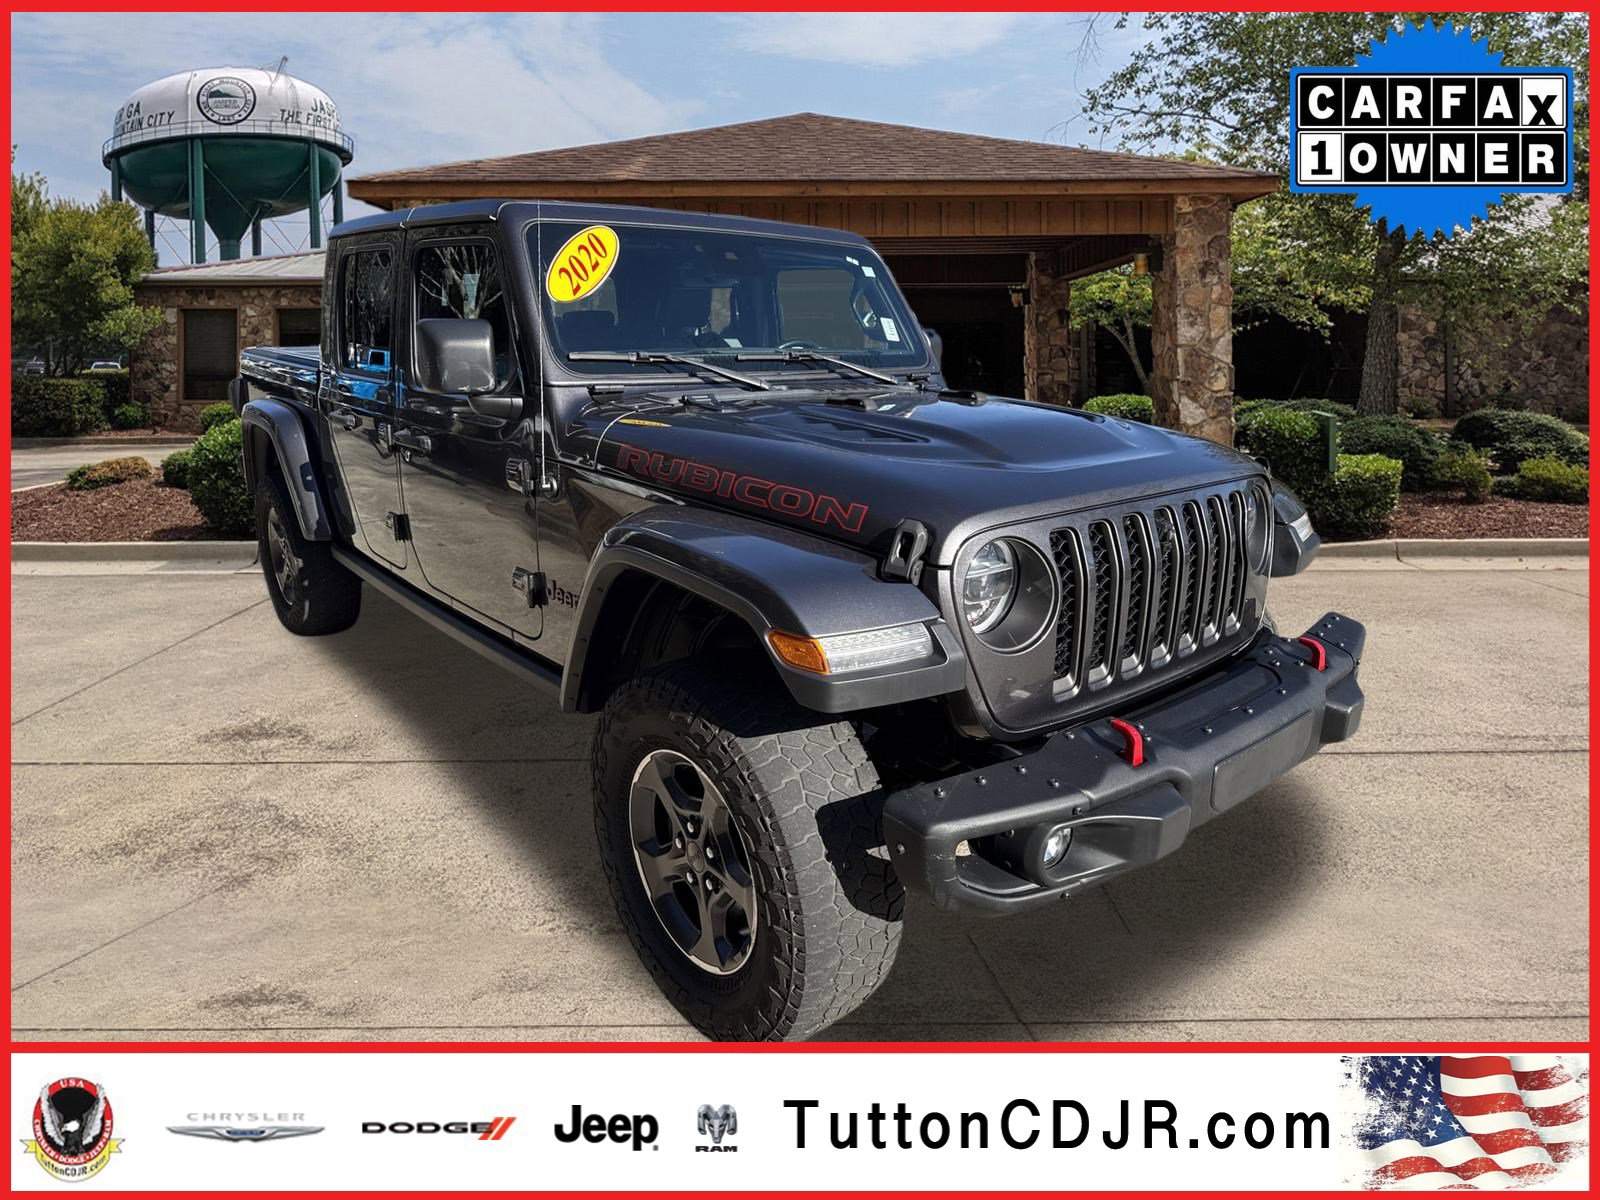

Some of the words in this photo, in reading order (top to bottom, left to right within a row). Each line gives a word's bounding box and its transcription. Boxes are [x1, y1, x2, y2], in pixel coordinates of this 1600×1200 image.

[127, 101, 141, 119] GA
[147, 110, 176, 127] CITY
[280, 109, 302, 125] THE
[558, 232, 608, 297] 2020
[616, 445, 869, 533] RUBICON
